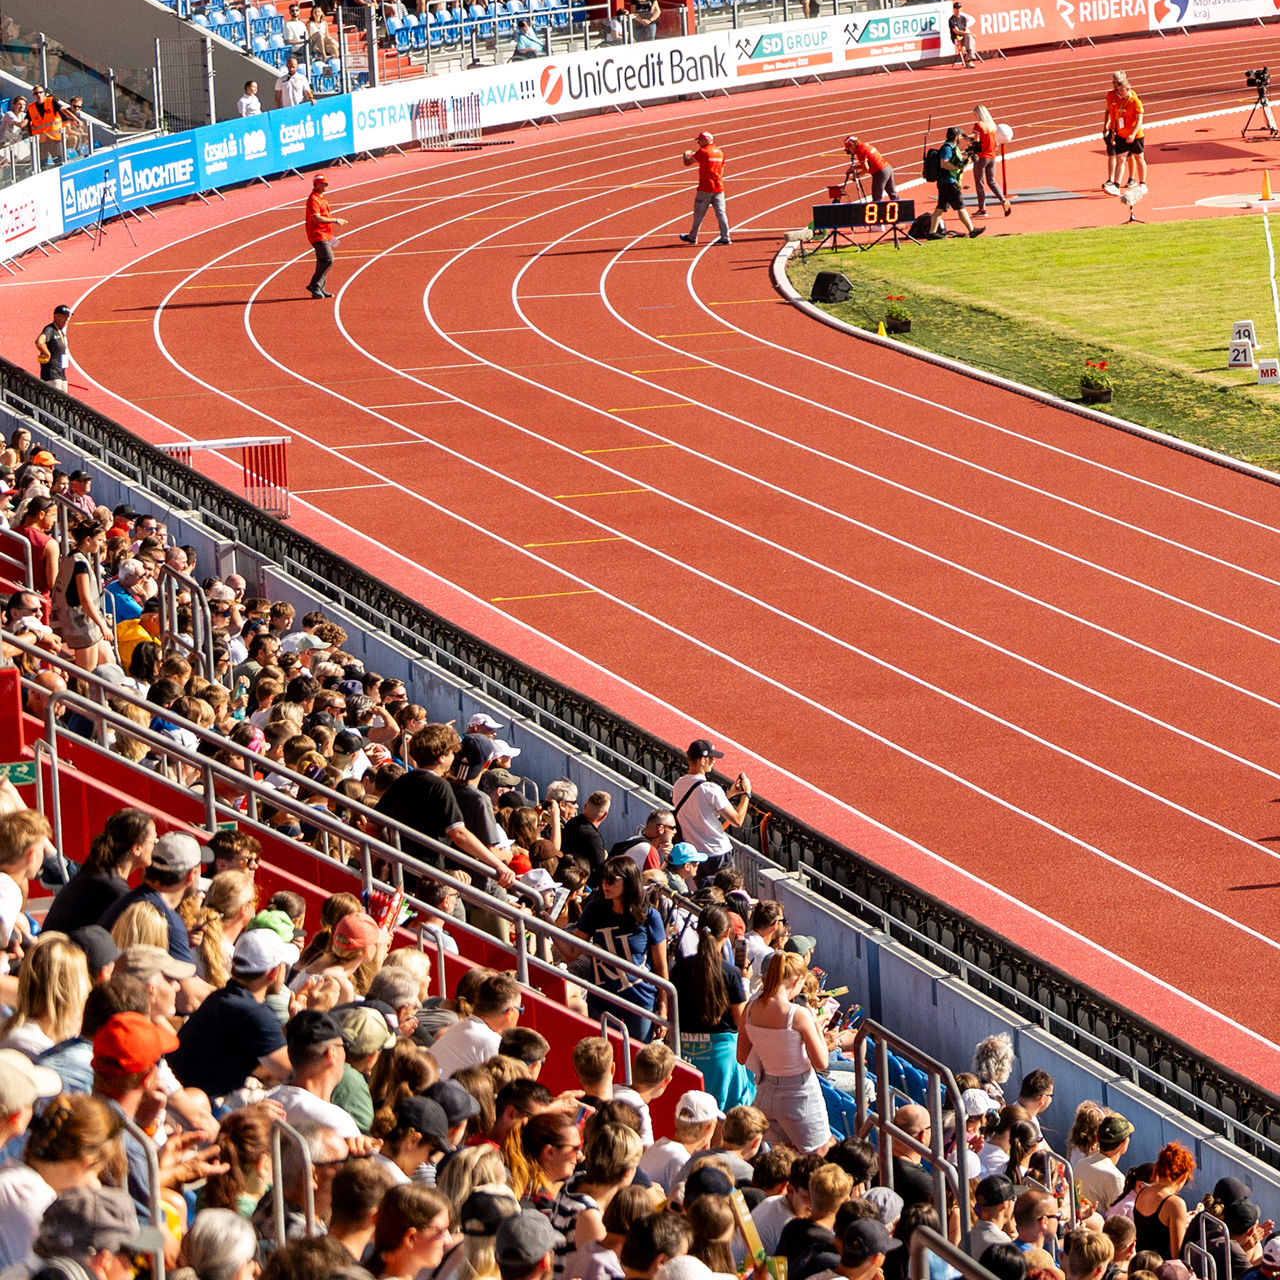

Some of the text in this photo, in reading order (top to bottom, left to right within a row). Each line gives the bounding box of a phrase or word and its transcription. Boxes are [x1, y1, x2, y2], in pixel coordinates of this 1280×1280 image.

[980, 7, 1046, 36] RIDERA
[1193, 8, 1211, 20] kraj
[869, 16, 937, 39] SD GROUP
[762, 30, 828, 54] SD GROUP
[567, 44, 729, 101] UniCredit Bank
[134, 158, 194, 193] HOCHTIEF
[864, 201, 899, 225] 8.0
[1235, 329, 1251, 341] 19
[1232, 348, 1248, 362] 21
[1260, 368, 1277, 378] MR
